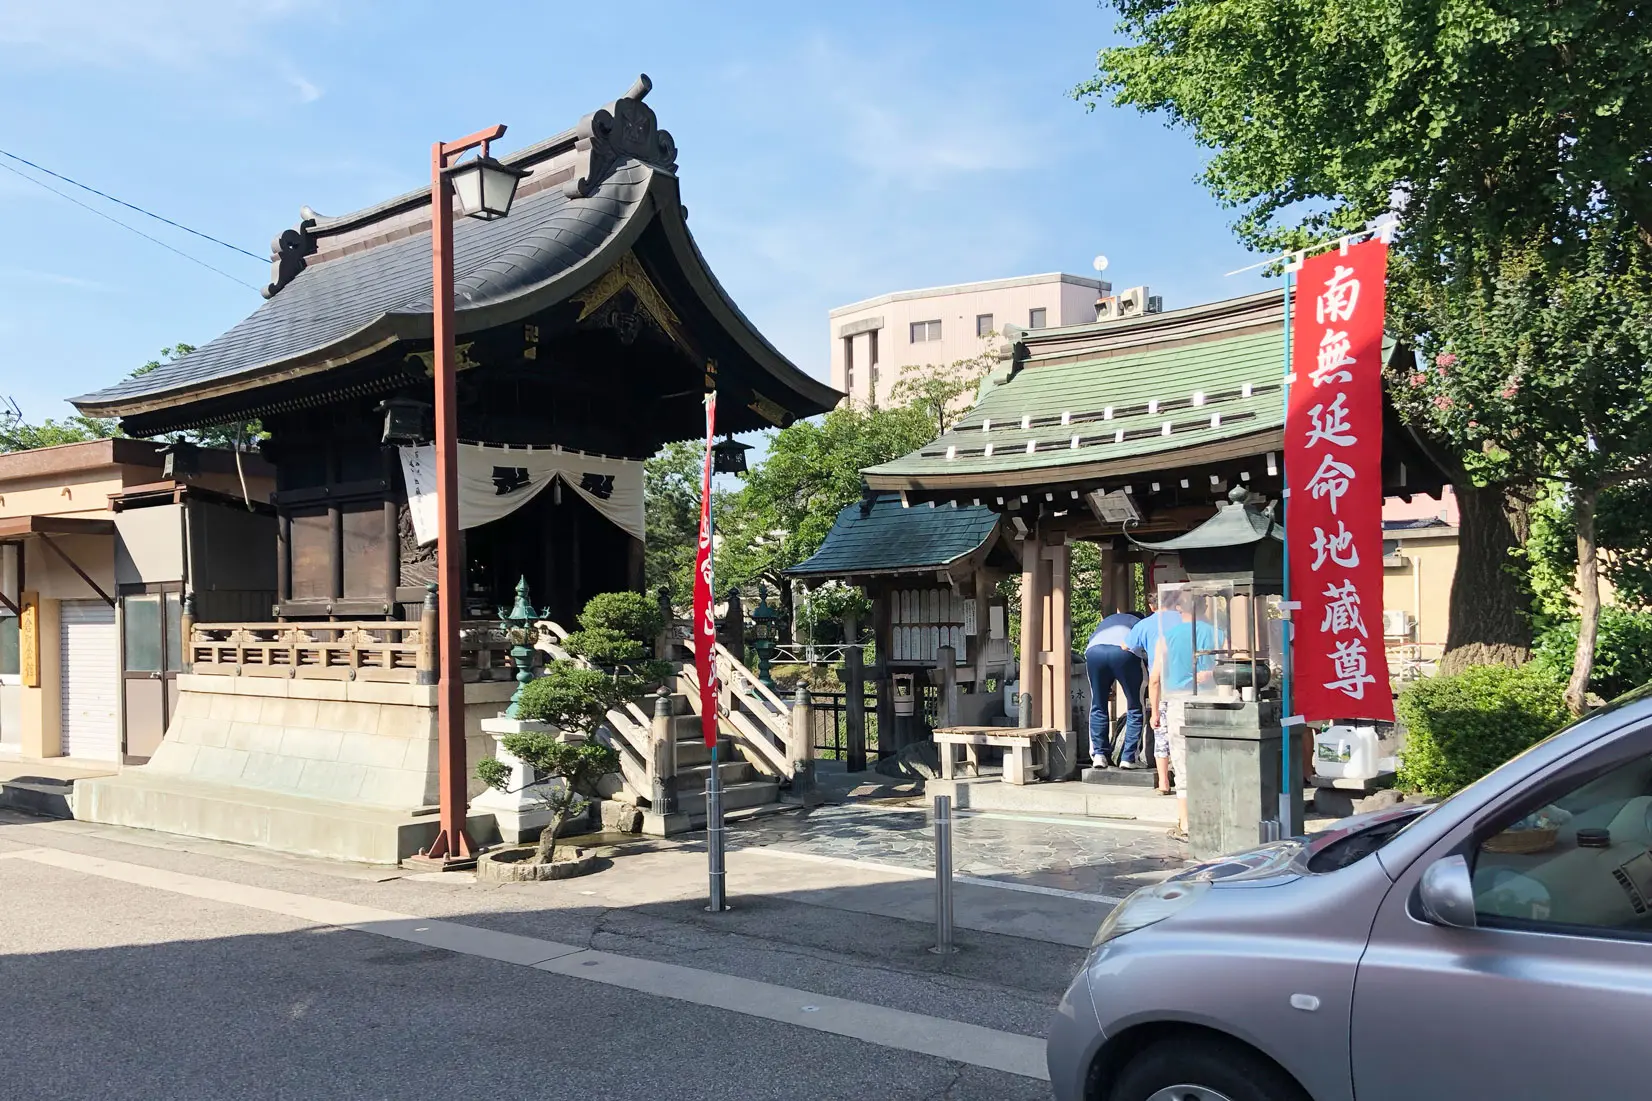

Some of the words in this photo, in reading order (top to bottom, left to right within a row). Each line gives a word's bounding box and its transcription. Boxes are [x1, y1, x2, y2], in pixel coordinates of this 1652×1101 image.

[1303, 265, 1376, 700] 南無延命地蔵尊
